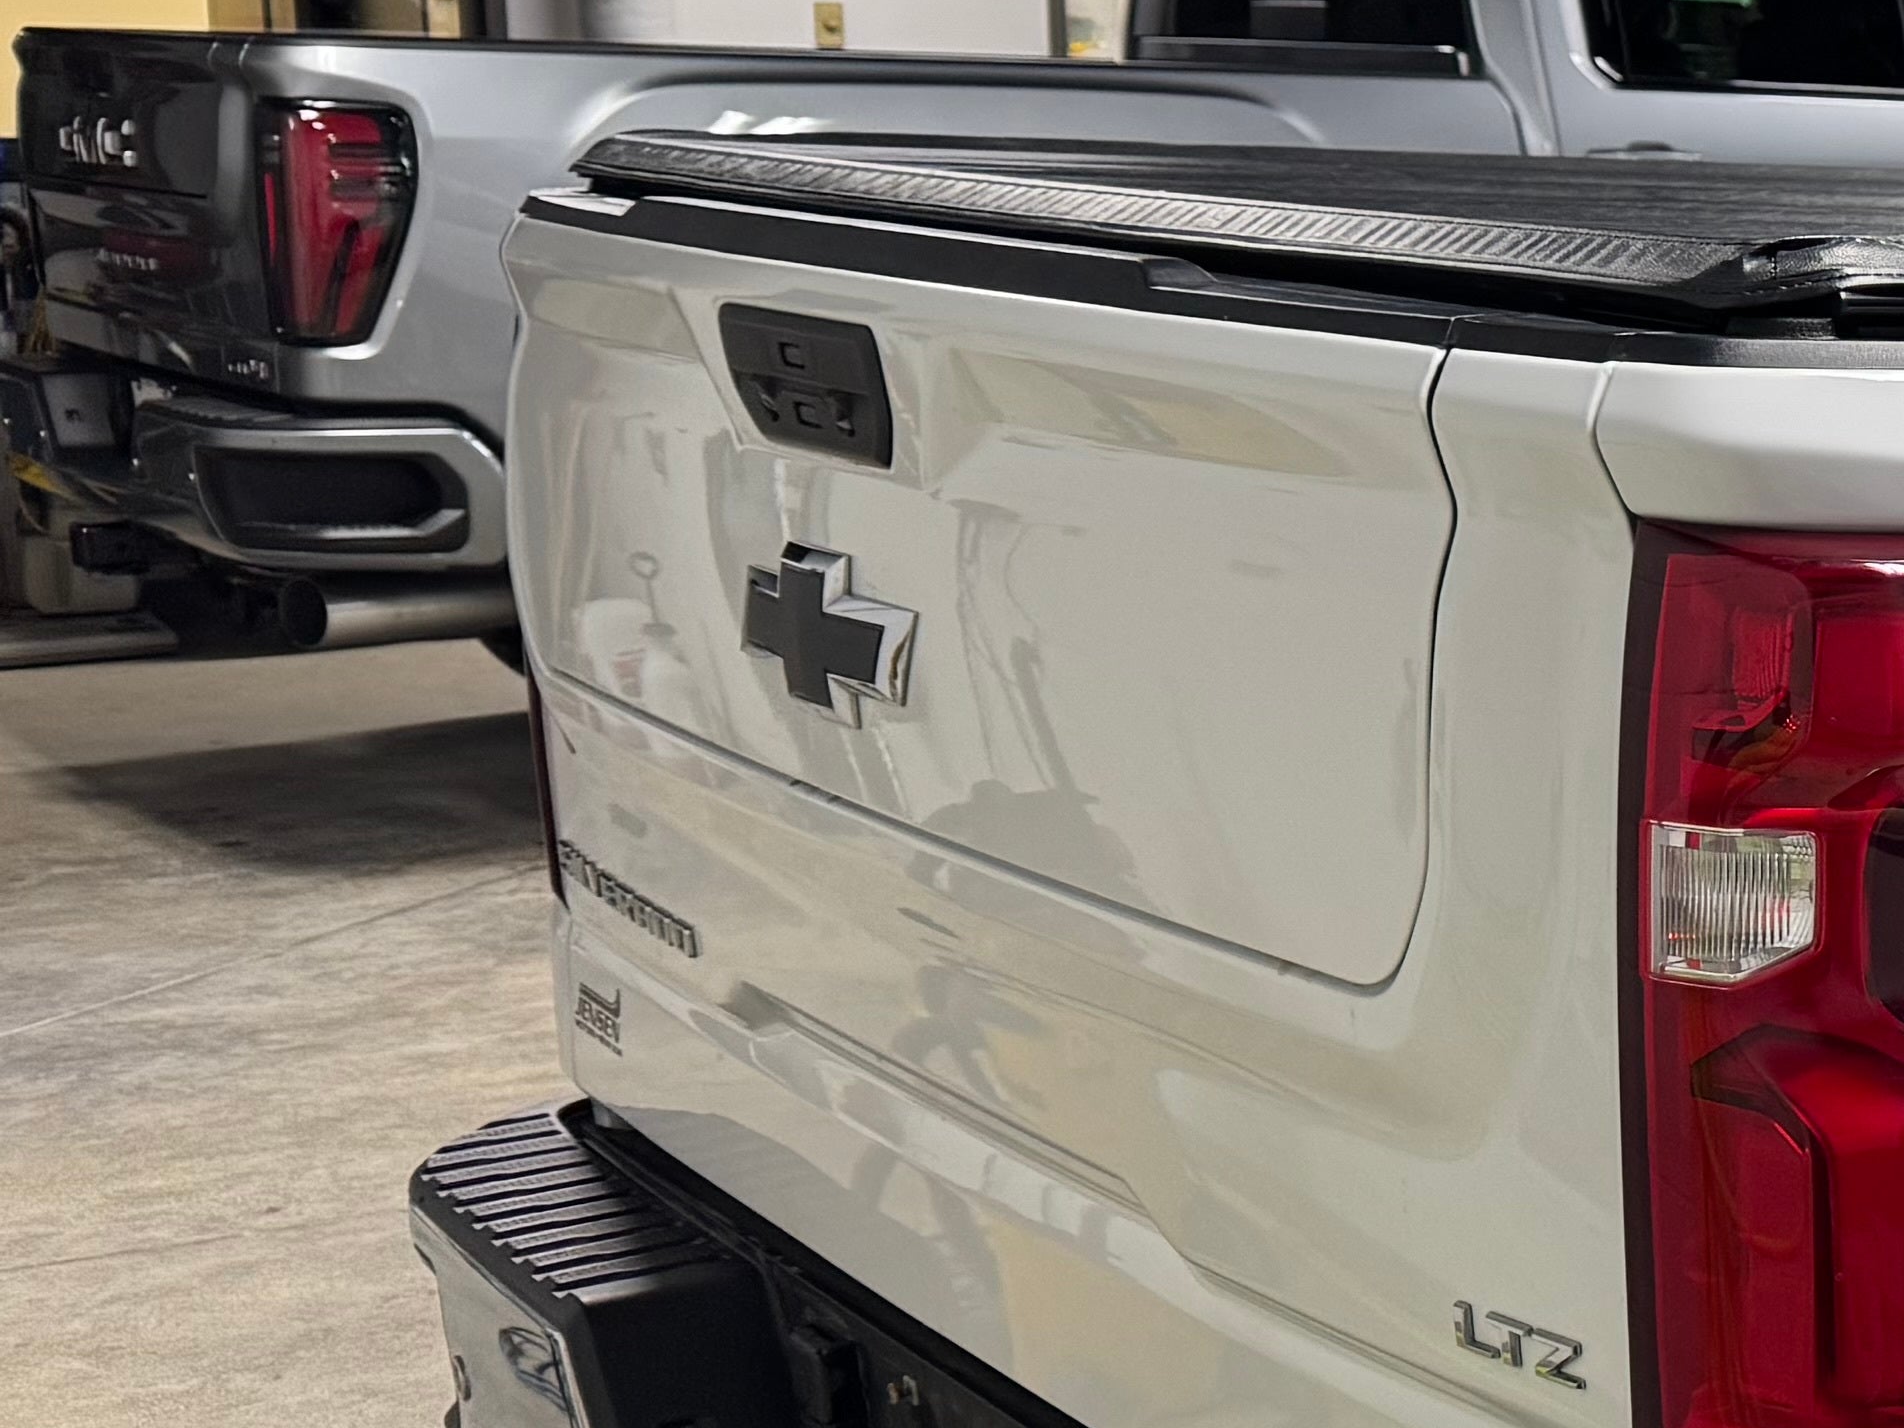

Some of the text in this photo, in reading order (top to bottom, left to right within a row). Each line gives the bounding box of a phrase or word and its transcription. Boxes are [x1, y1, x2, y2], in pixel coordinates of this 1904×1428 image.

[59, 115, 138, 168] GMC
[574, 996, 620, 1044] JENSEN
[1453, 1300, 1586, 1390] LTZ
